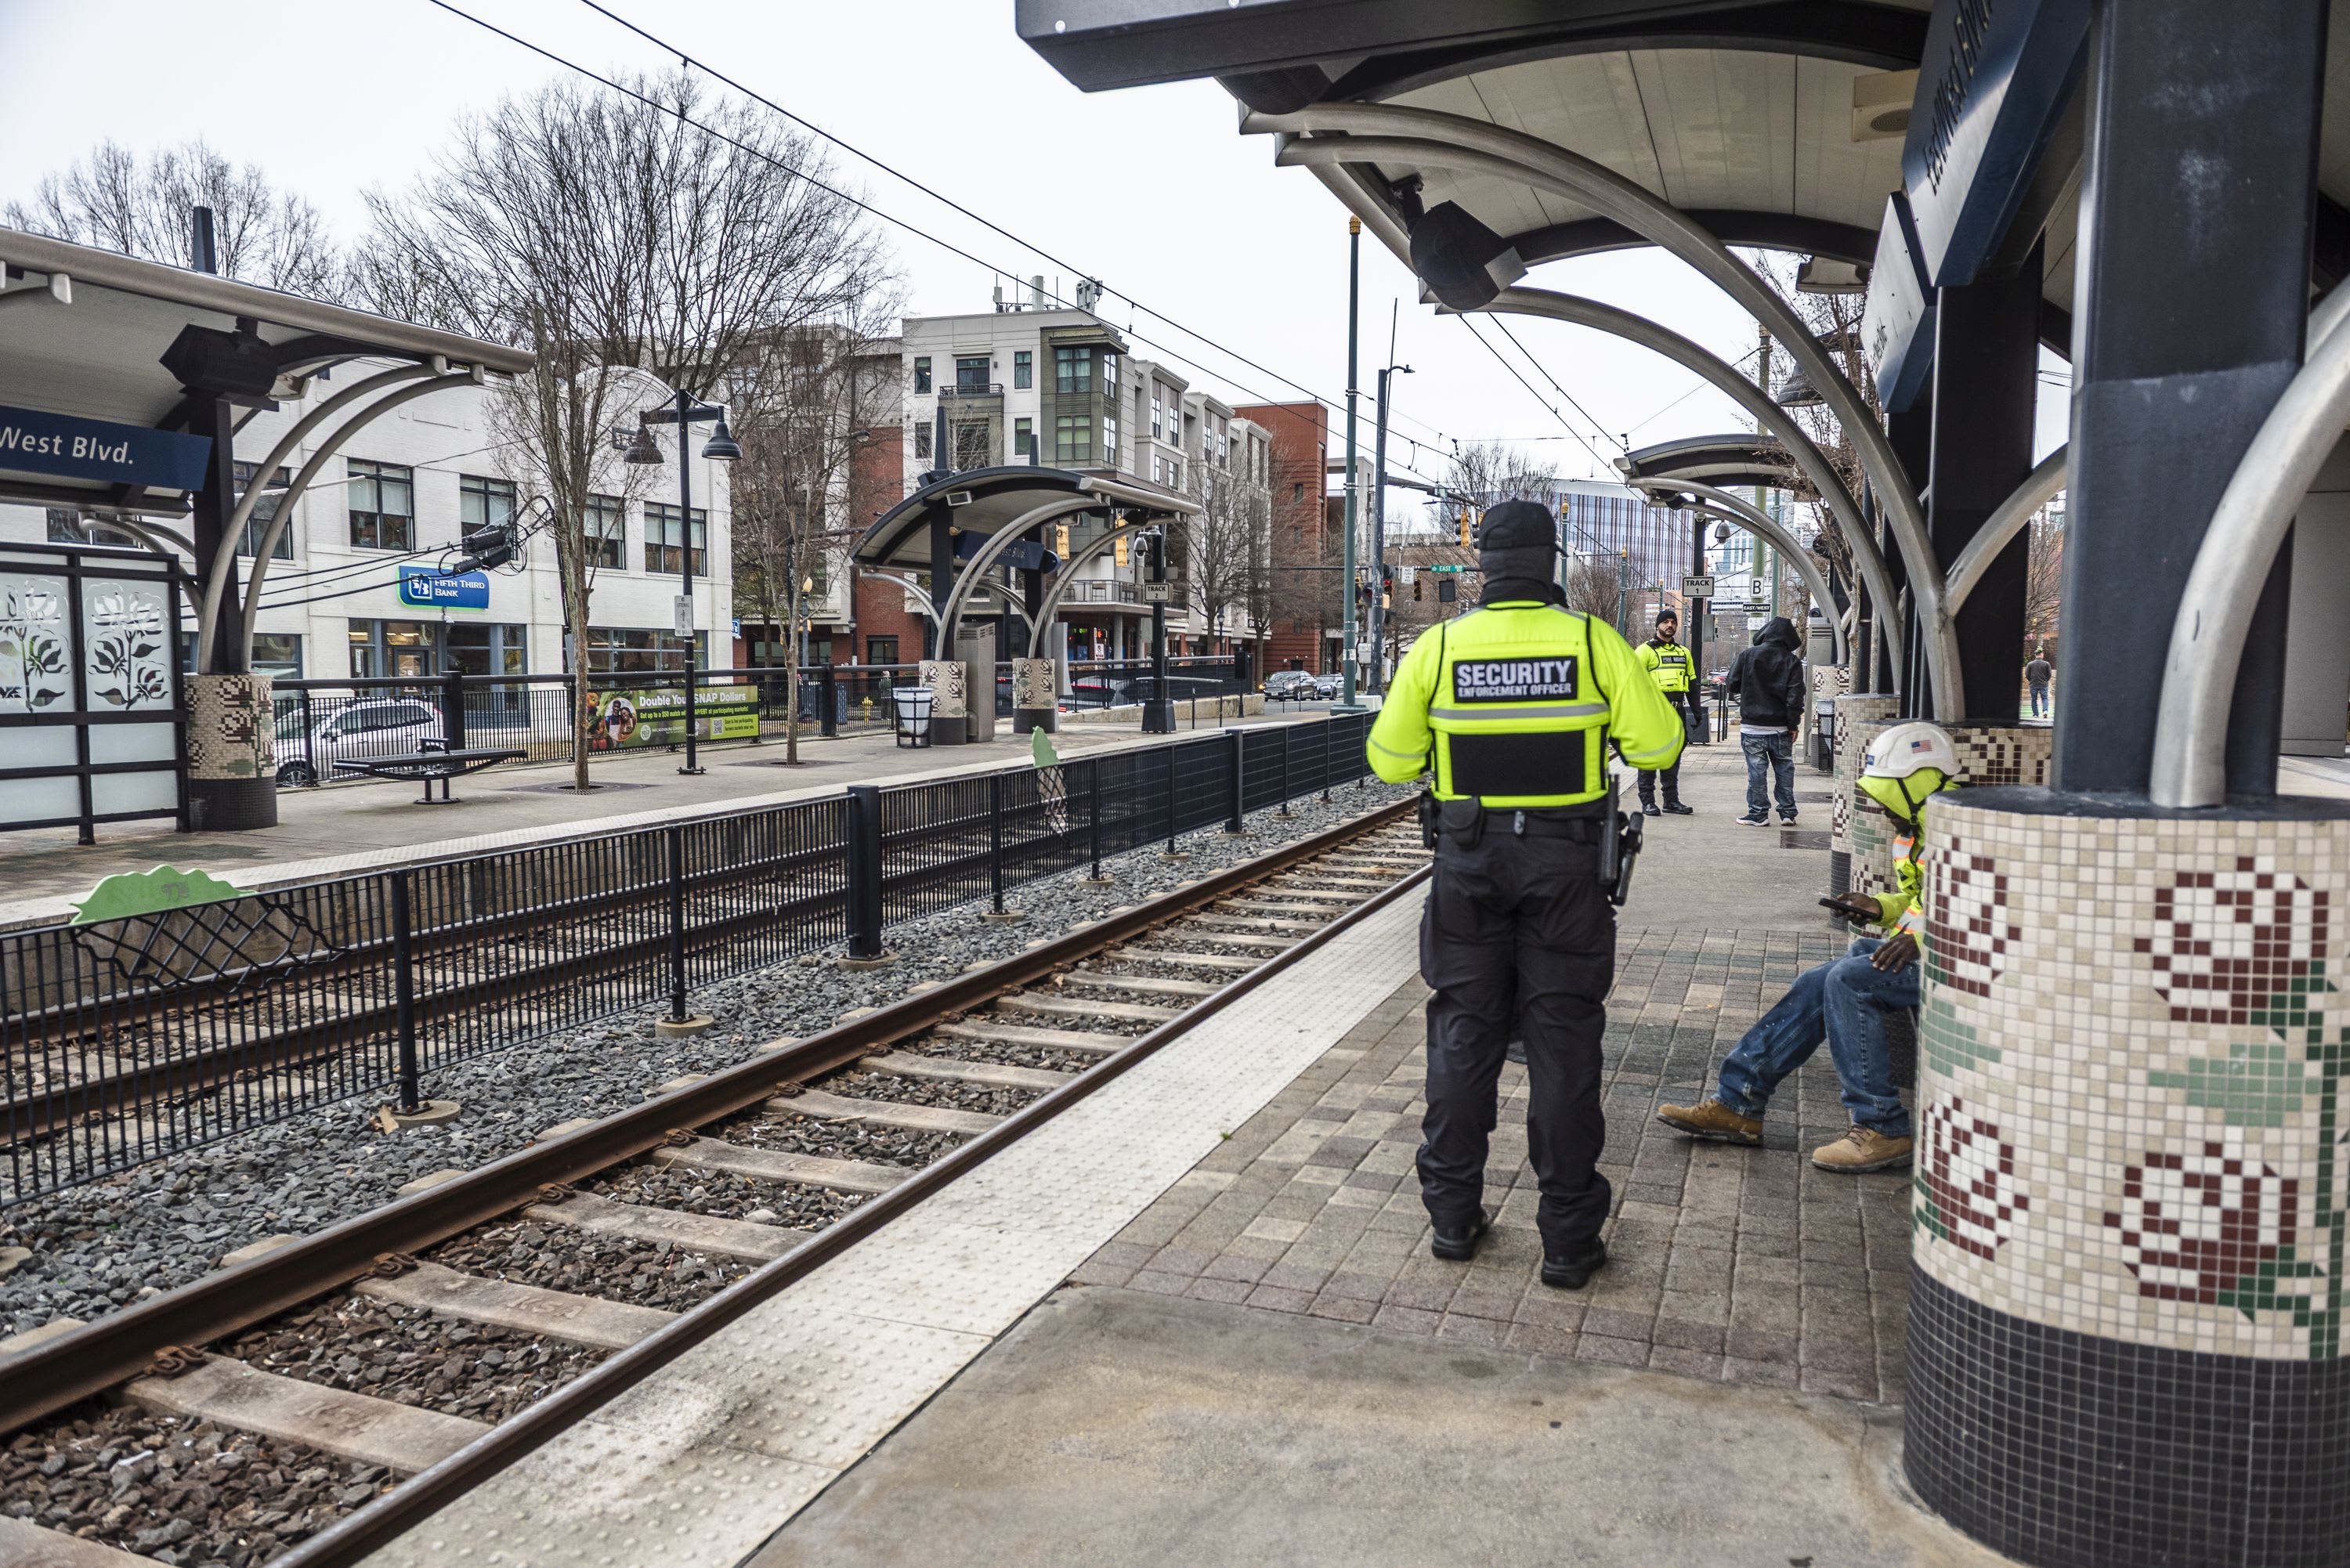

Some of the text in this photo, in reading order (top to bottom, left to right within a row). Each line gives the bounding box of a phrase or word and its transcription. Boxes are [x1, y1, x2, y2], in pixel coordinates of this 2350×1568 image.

[72, 436, 133, 464] Blvd.
[460, 580, 485, 589] THIRD
[1753, 580, 1761, 594] B
[1457, 660, 1571, 687] SECURITY
[1458, 683, 1571, 697] ENFORCEMENT OFFICER
[639, 692, 746, 706] Double You SNAP Dollars
